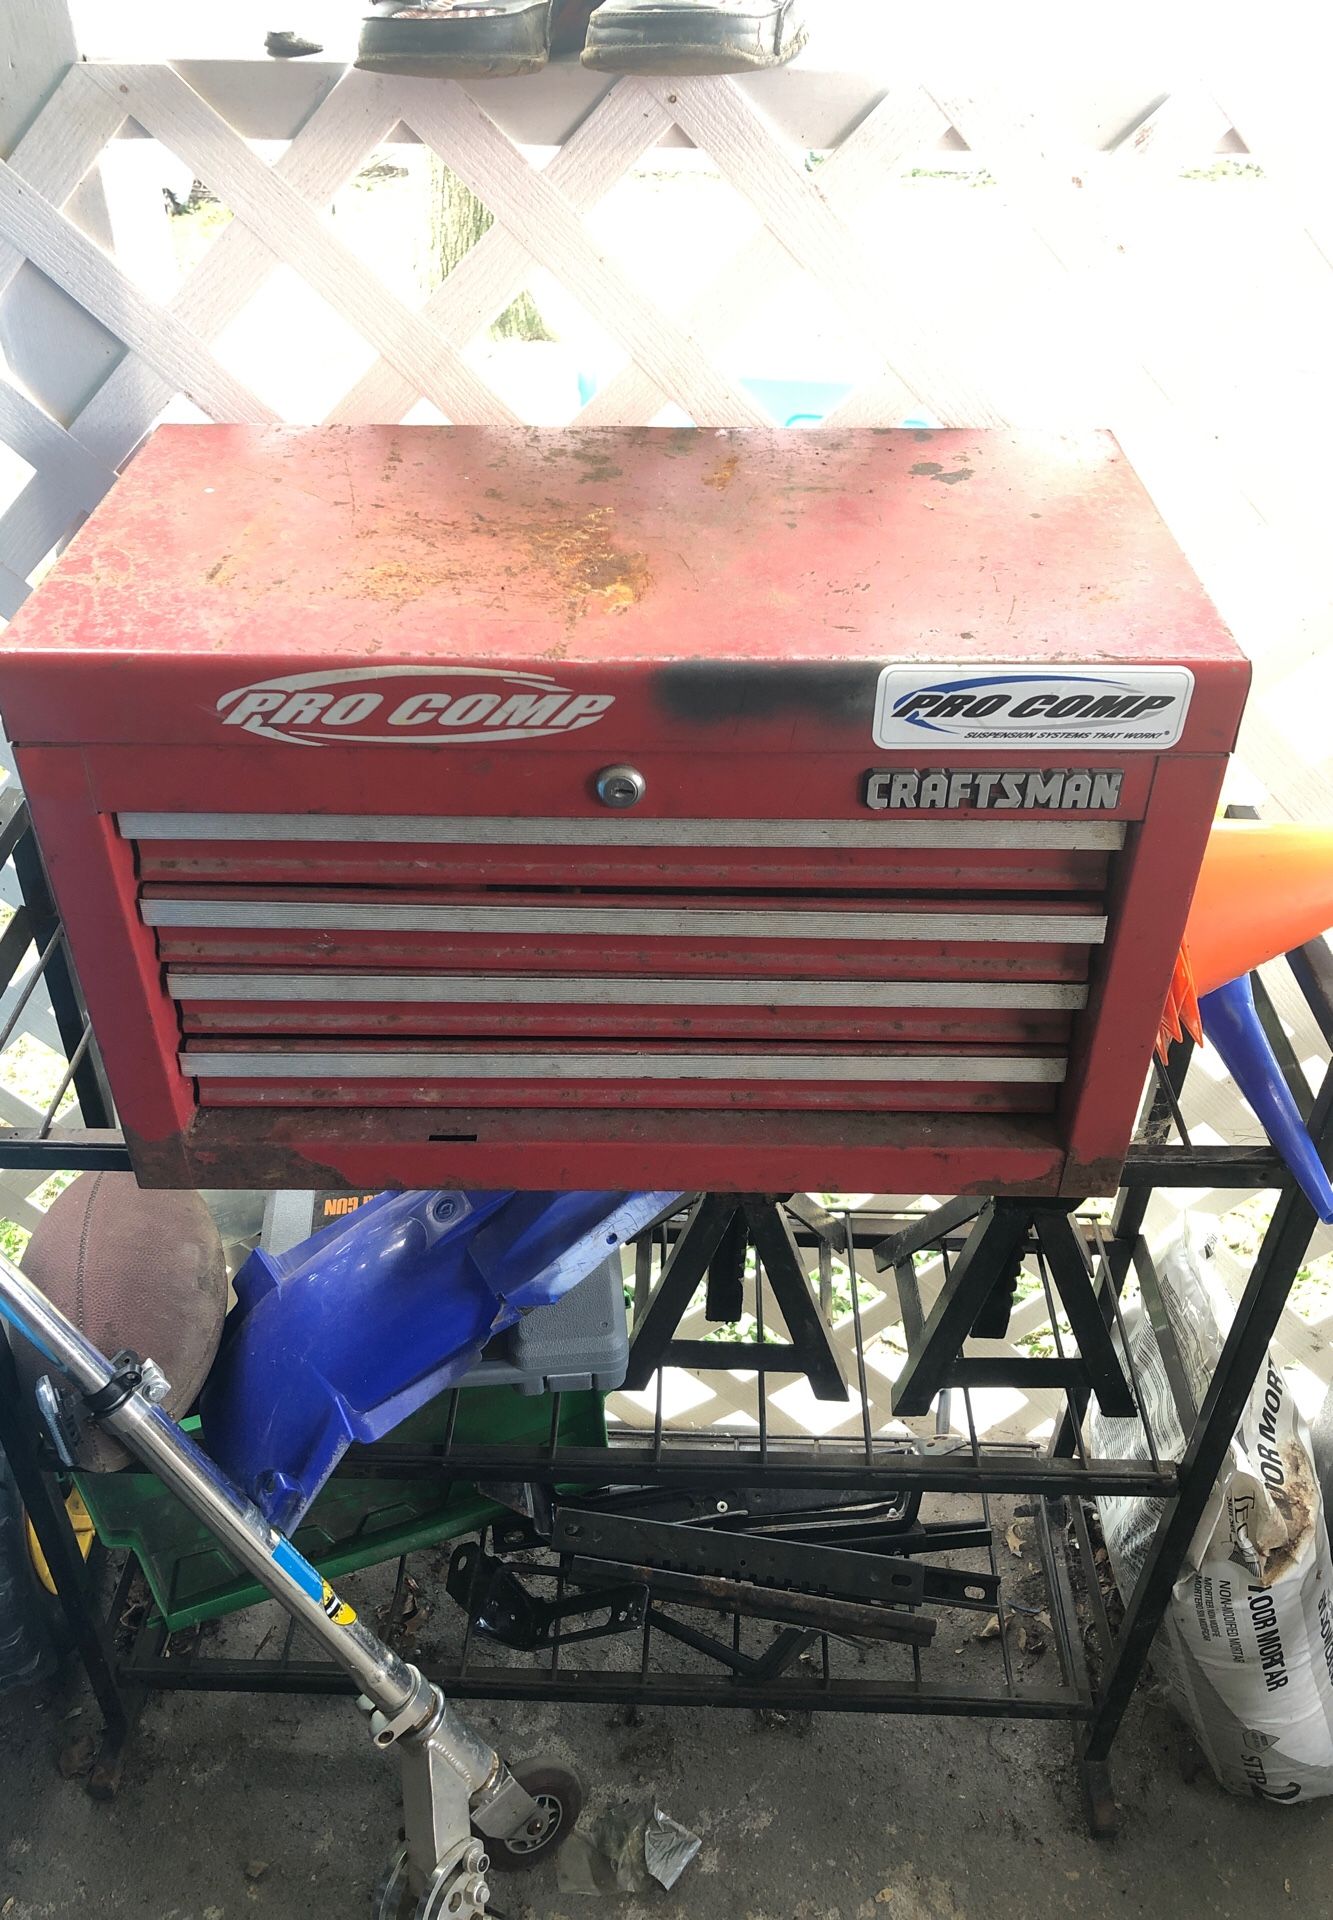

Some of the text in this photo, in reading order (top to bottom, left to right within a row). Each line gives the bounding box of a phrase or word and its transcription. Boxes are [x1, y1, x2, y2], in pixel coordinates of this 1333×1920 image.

[222, 692, 616, 728] PRO COMP
[891, 694, 1176, 719] PRO COMP
[964, 731, 1035, 739] SUSPENSION
[1036, 731, 1091, 739] SYSTEMS
[1091, 731, 1124, 739] THAT
[865, 769, 1124, 810] CRAFTSMAN
[324, 1196, 358, 1216] GUN
[1193, 1575, 1204, 1609] MORTERO
[1204, 1577, 1215, 1609] MORTIER
[1219, 1580, 1246, 1663] NON-MODIFIED MORTAR
[1256, 1628, 1289, 1692] MORTAR
